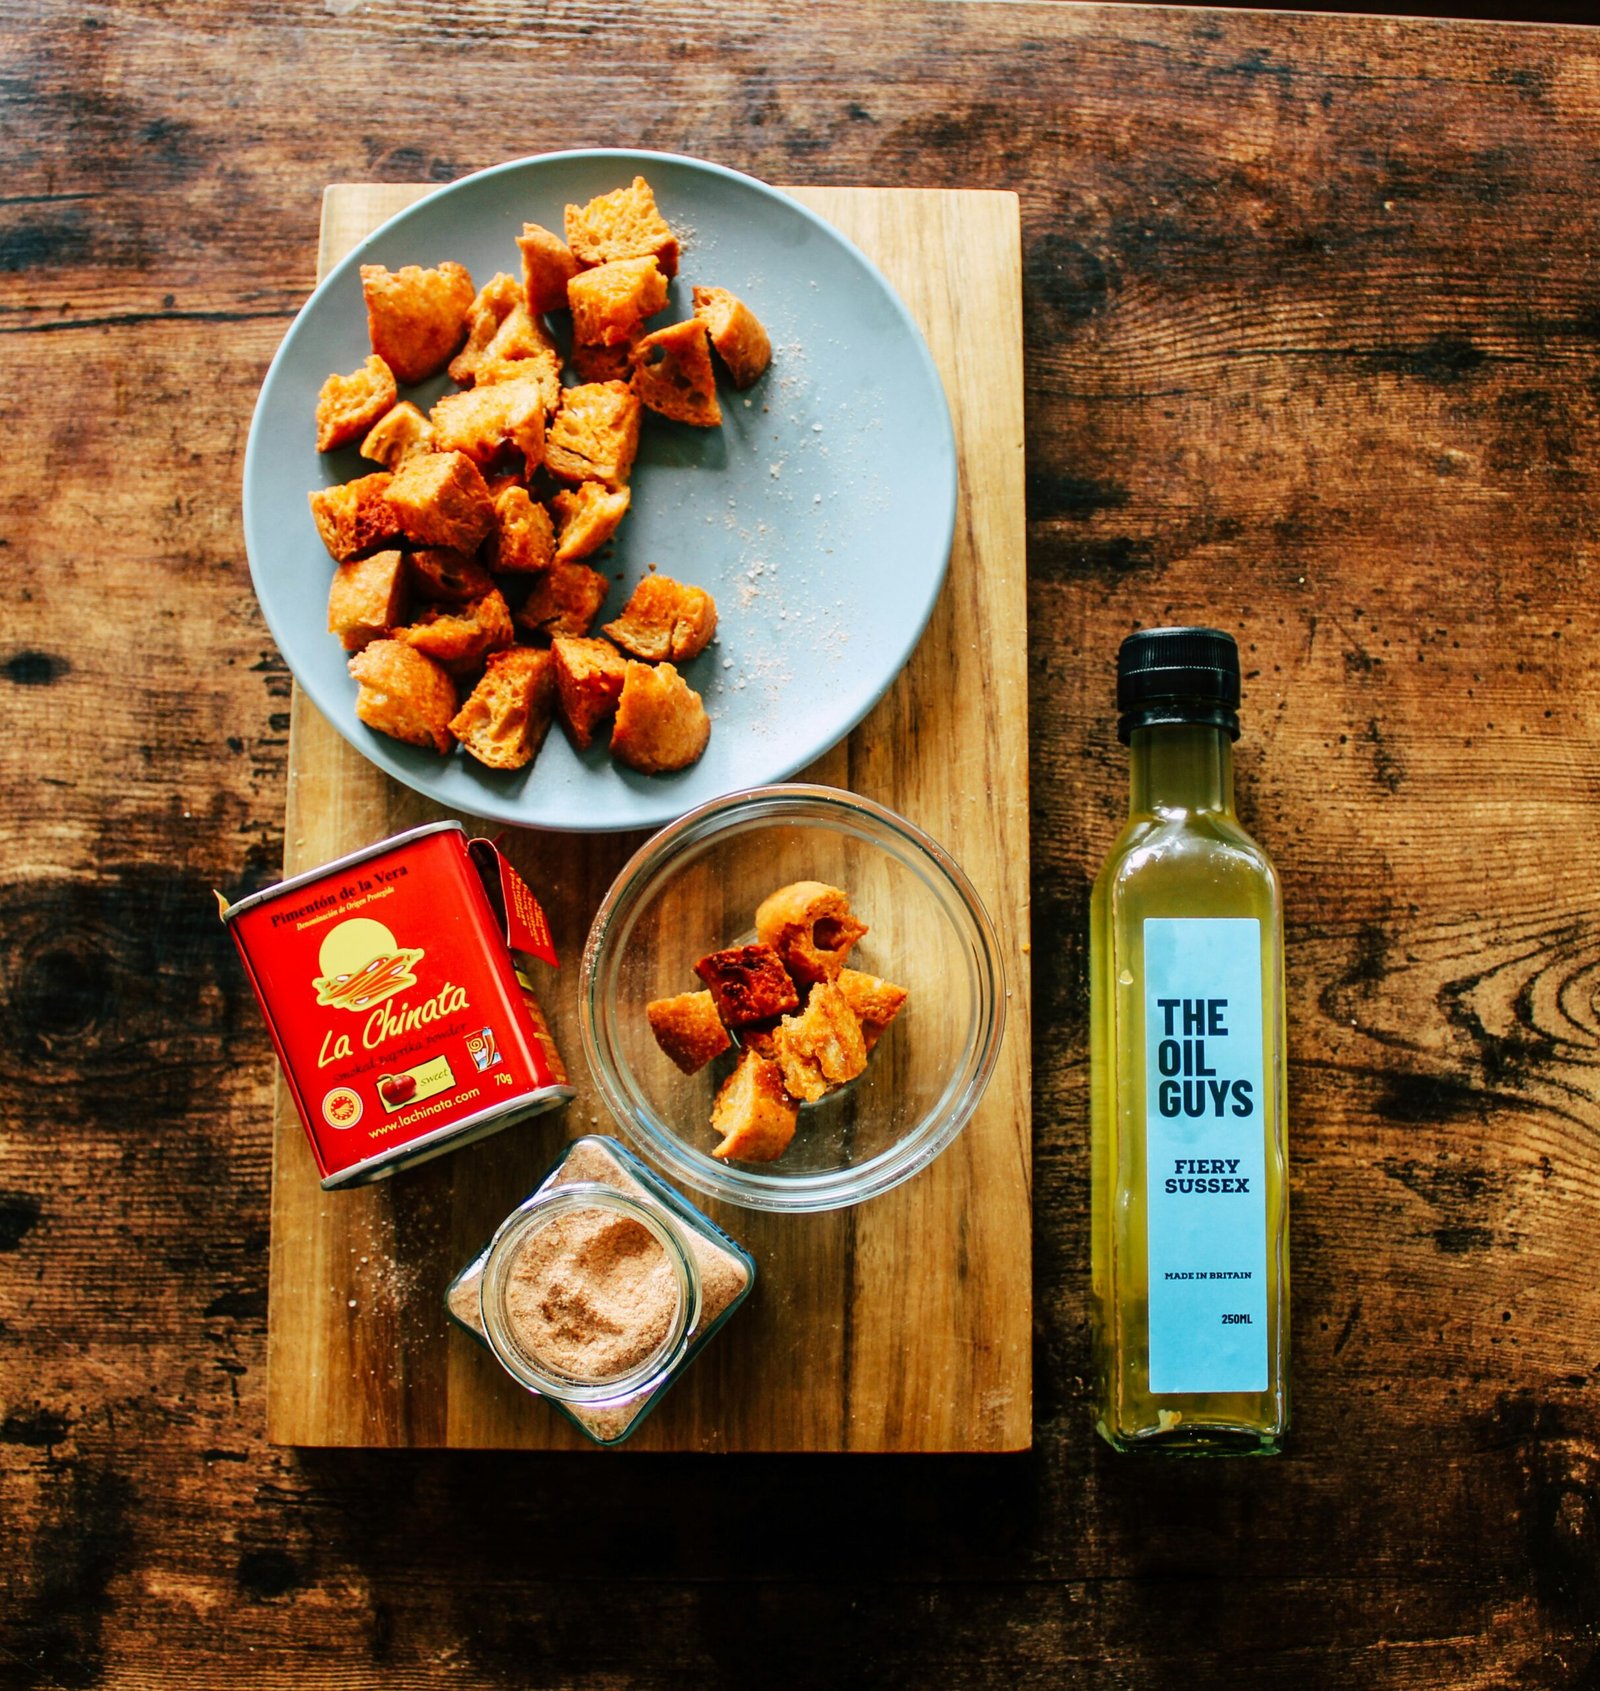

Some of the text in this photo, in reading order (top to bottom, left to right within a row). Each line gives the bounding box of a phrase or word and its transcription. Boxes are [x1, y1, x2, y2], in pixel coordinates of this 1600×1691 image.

[270, 865, 408, 928] Pimentón de la Vera
[338, 905, 346, 915] de
[346, 896, 367, 911] Origen
[317, 1029, 354, 1069] La
[361, 981, 470, 1050] Chinata
[1157, 998, 1229, 1036] THE
[1158, 1039, 1217, 1077] OIL
[419, 1067, 449, 1087] sweet
[494, 1072, 513, 1087] 70g
[1158, 1079, 1254, 1118] GUYS
[368, 1087, 481, 1140] www.lachinata.com
[1175, 1159, 1240, 1174] FIERY
[1165, 1178, 1250, 1194] SUSSEX
[1164, 1271, 1252, 1280] MADE IN BRITAIN
[1221, 1314, 1253, 1324] 250ML
